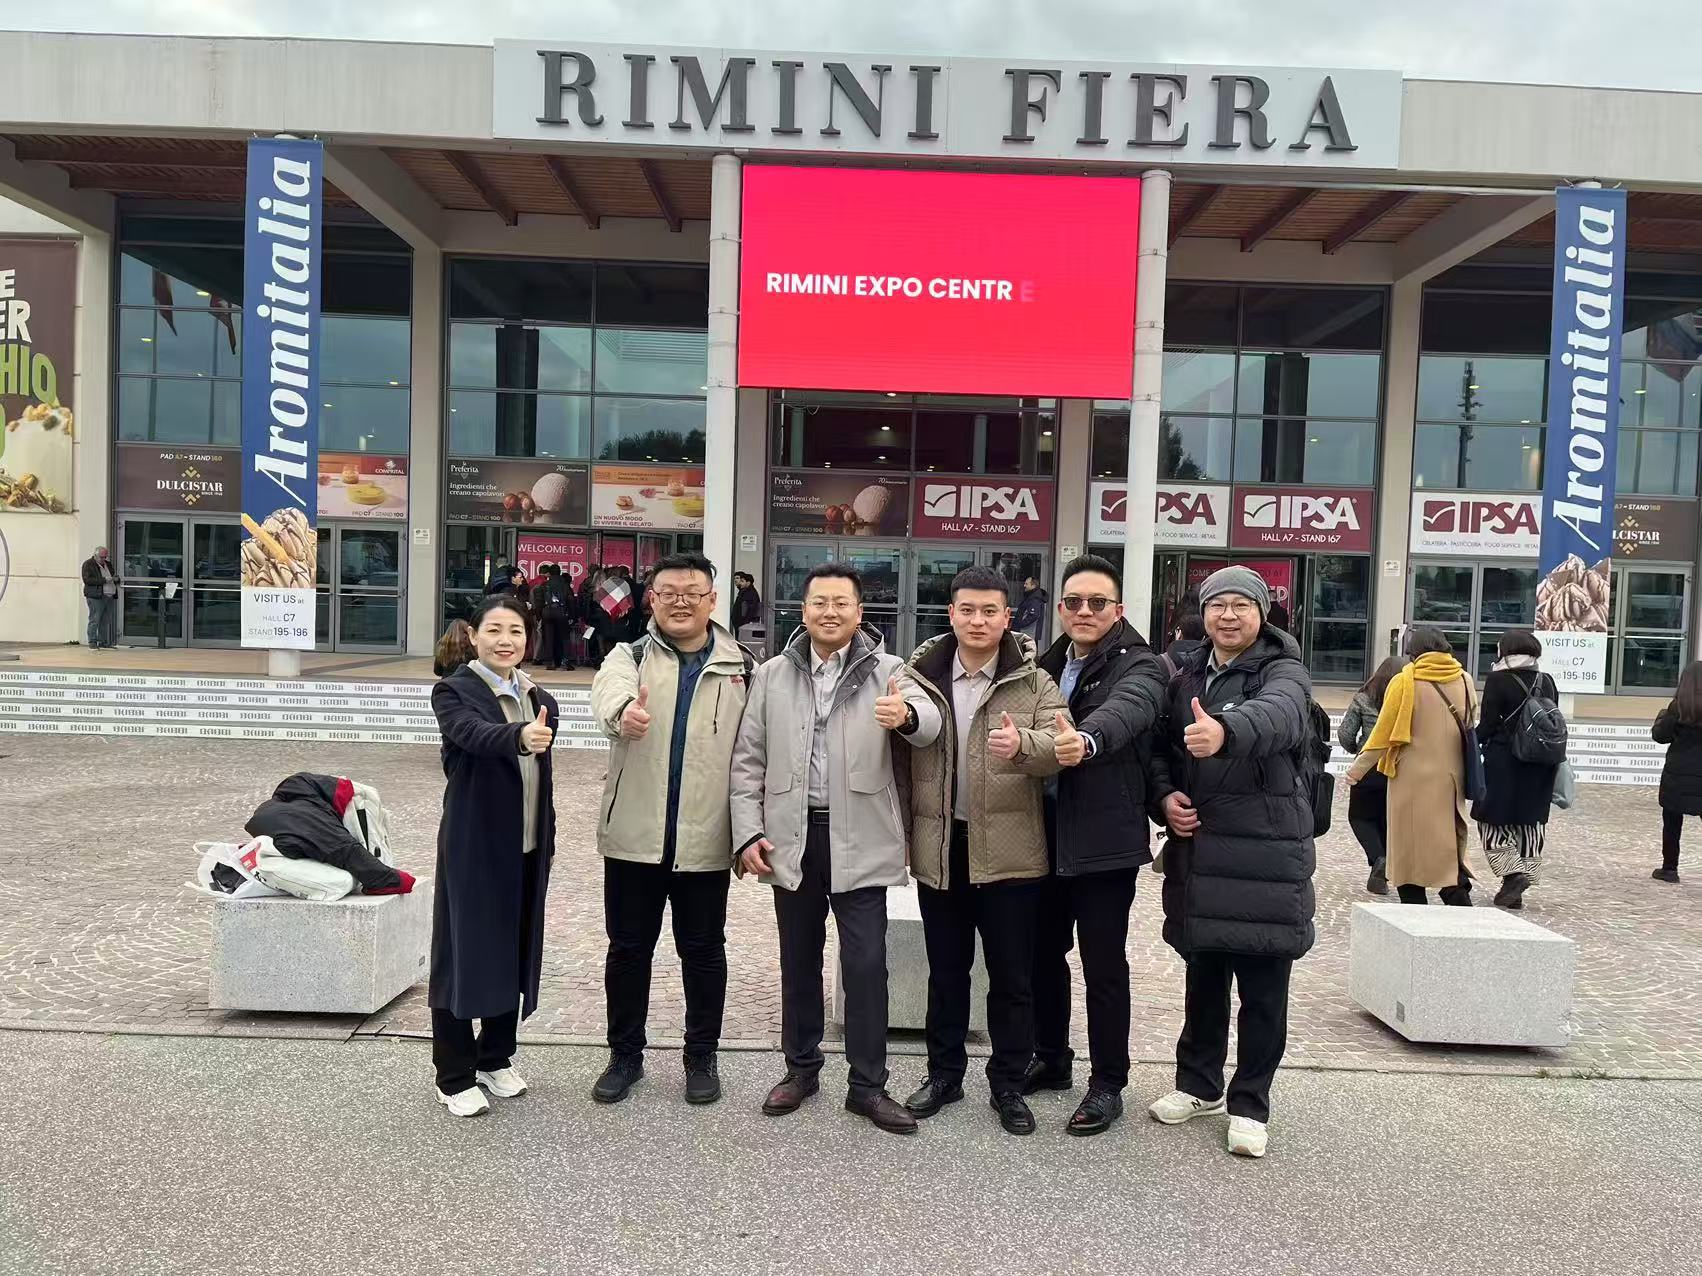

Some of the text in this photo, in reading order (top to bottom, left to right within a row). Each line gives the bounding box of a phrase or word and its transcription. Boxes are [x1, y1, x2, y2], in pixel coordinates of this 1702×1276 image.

[535, 49, 1359, 151] RIMINI FIERA
[766, 272, 848, 295] RIMINI
[855, 275, 923, 297] EXPO
[255, 156, 310, 507] Aromitalia
[1552, 204, 1614, 551] Aromitalia
[450, 464, 479, 473] Preferita
[156, 479, 223, 492] DULCISTAR
[774, 476, 803, 485] Preferita
[450, 482, 497, 491] Ingredienti che
[449, 489, 505, 499] creano capolavori
[773, 494, 808, 503] Ingredienti
[959, 485, 1040, 521] IPSA
[1154, 491, 1217, 526] PSA
[1628, 503, 1650, 511] STAND
[1280, 495, 1361, 531] IPSA
[1459, 501, 1540, 535] IPSA
[941, 522, 961, 531] HALL
[962, 523, 974, 532] A7
[981, 524, 1006, 533] STAND
[1007, 525, 1021, 534] 167
[1261, 533, 1281, 542] HALL
[1282, 533, 1294, 542] A7
[1300, 534, 1326, 543] STAND
[1327, 534, 1342, 543] 167
[1612, 529, 1660, 541] LCISTAR
[518, 543, 584, 555] WELCOME TO
[254, 593, 280, 603] VISIT
[283, 594, 296, 604] US
[283, 613, 296, 622] C7
[248, 626, 308, 637] STAND 195-196
[1545, 638, 1571, 647] VISIT
[1572, 639, 1587, 648] US
[1572, 657, 1585, 666] C7
[1563, 671, 1598, 681] 195-196
[1191, 1099, 1201, 1109] N
